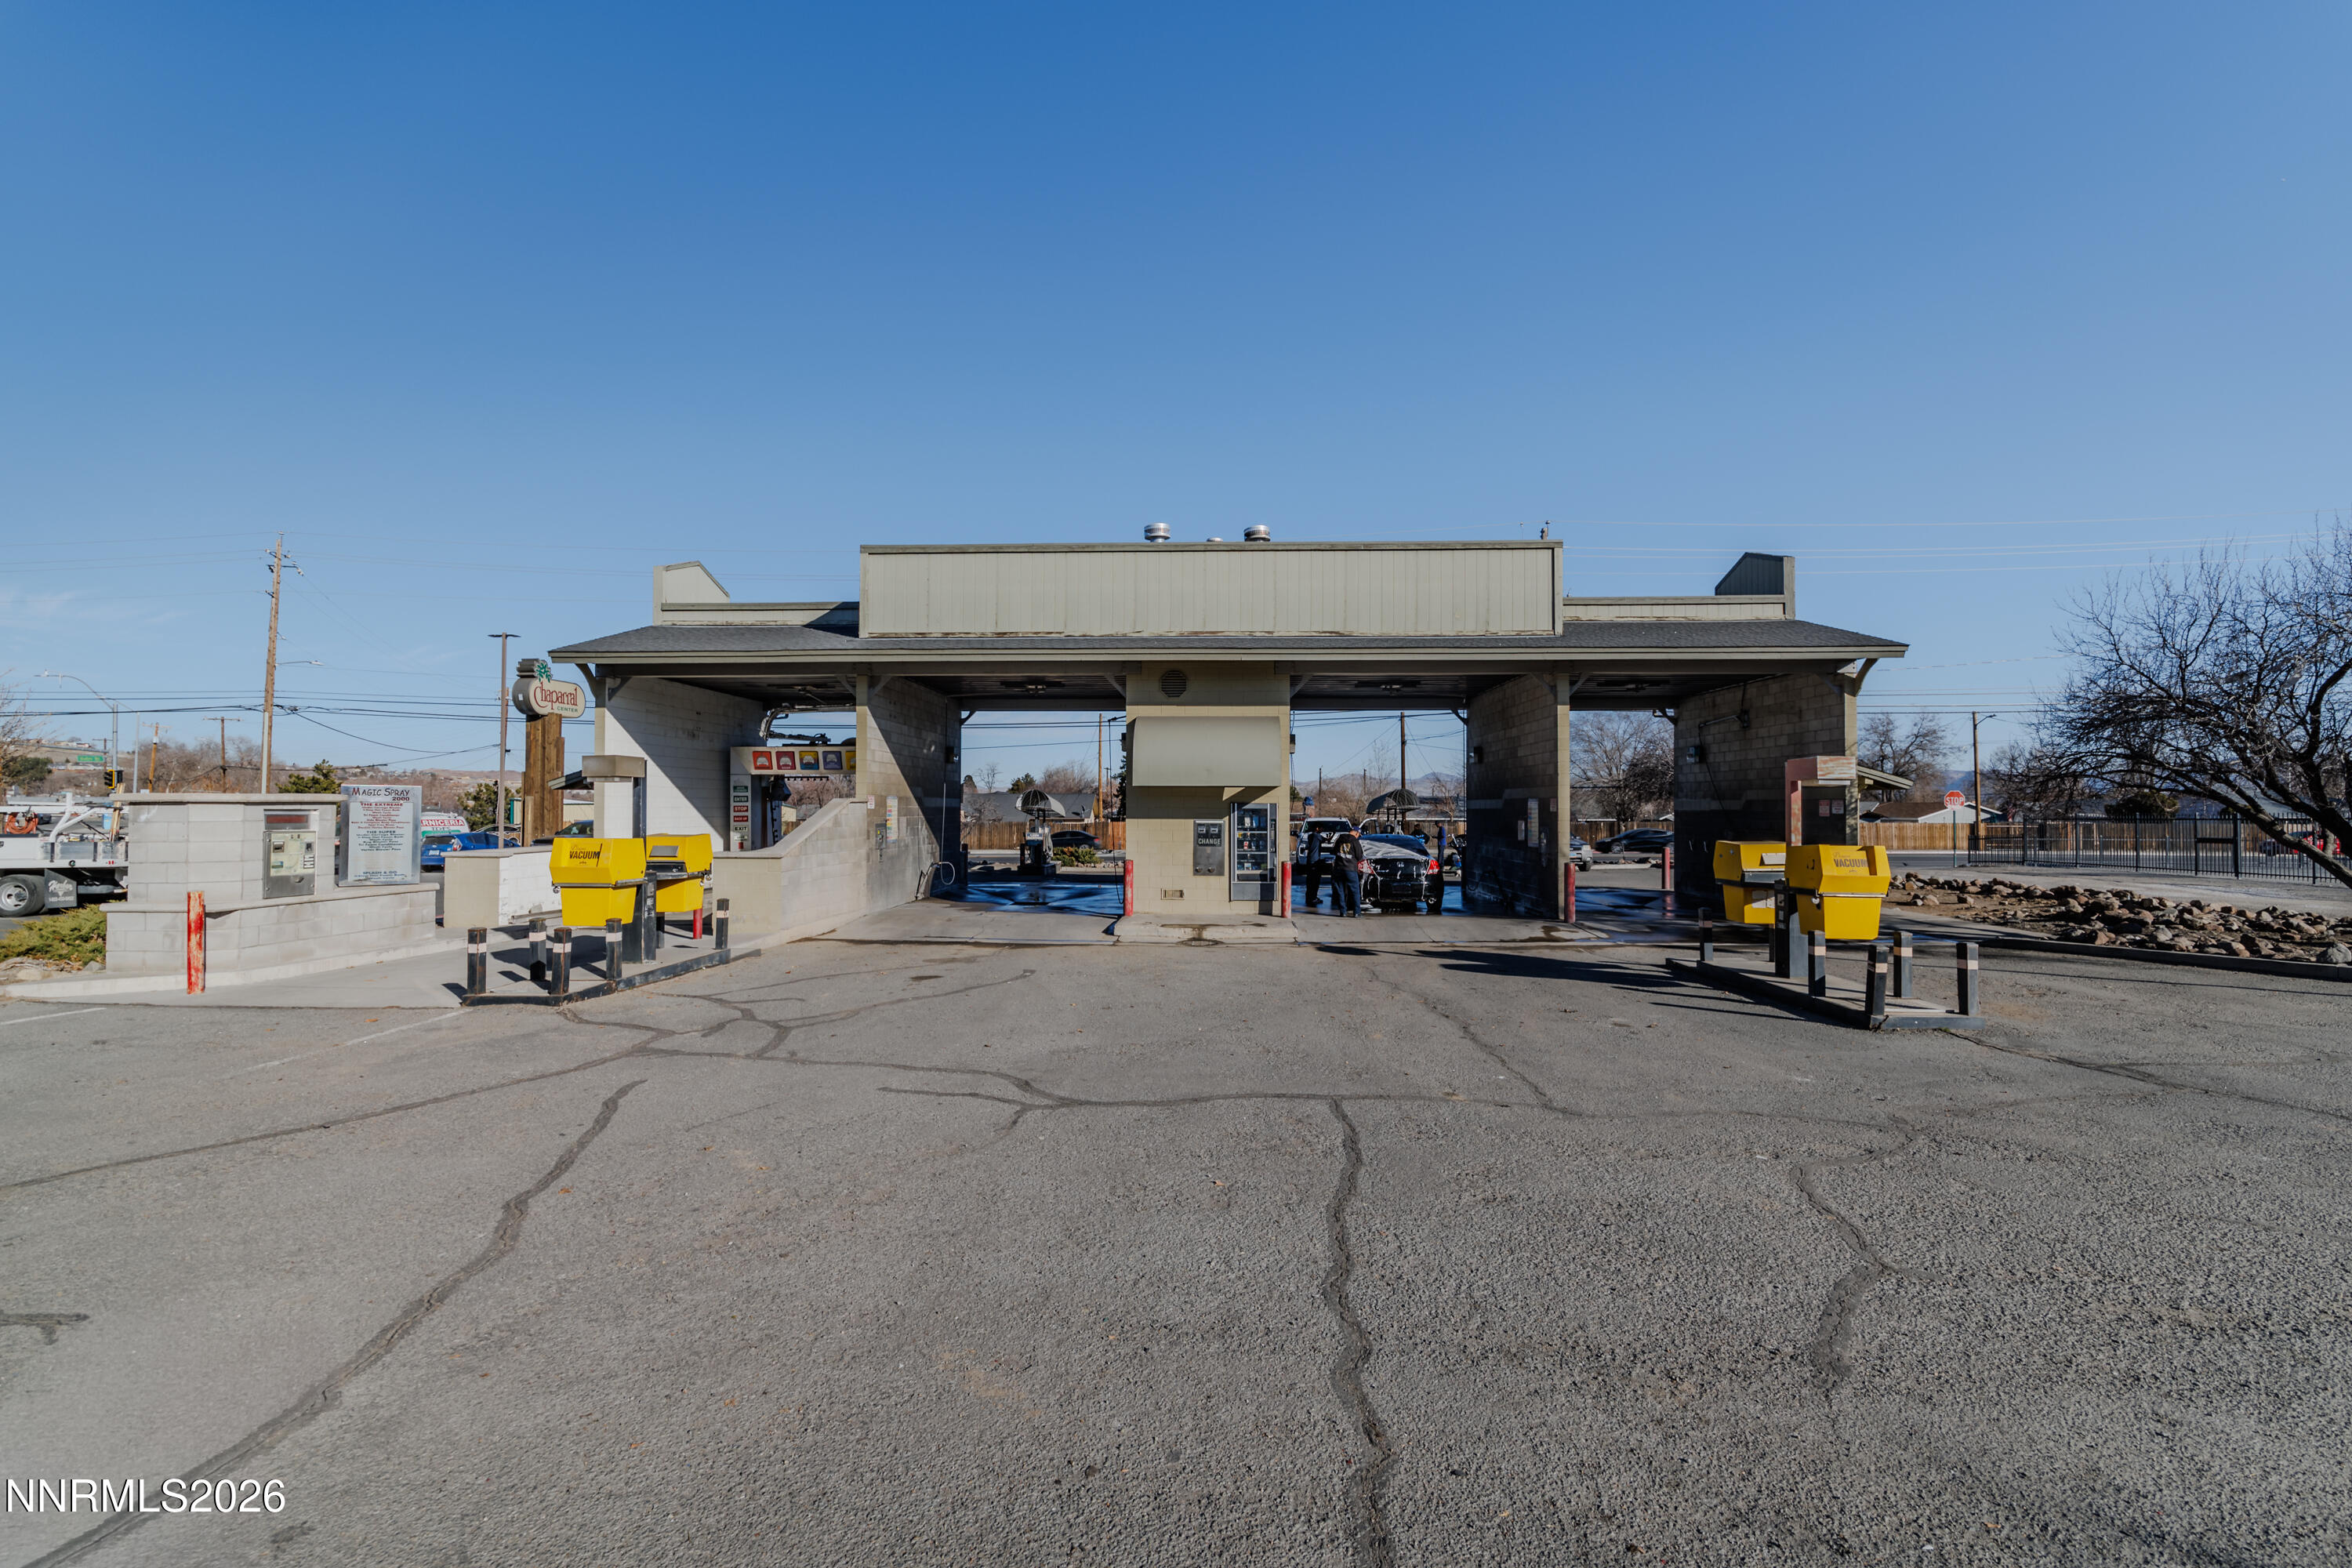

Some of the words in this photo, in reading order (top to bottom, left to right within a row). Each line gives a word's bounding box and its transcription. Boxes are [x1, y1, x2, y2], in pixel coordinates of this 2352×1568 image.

[534, 681, 578, 710] Chaparral
[351, 787, 382, 796] MAGIC
[383, 788, 410, 797] SPRAY
[1833, 858, 1868, 867] VACUUM
